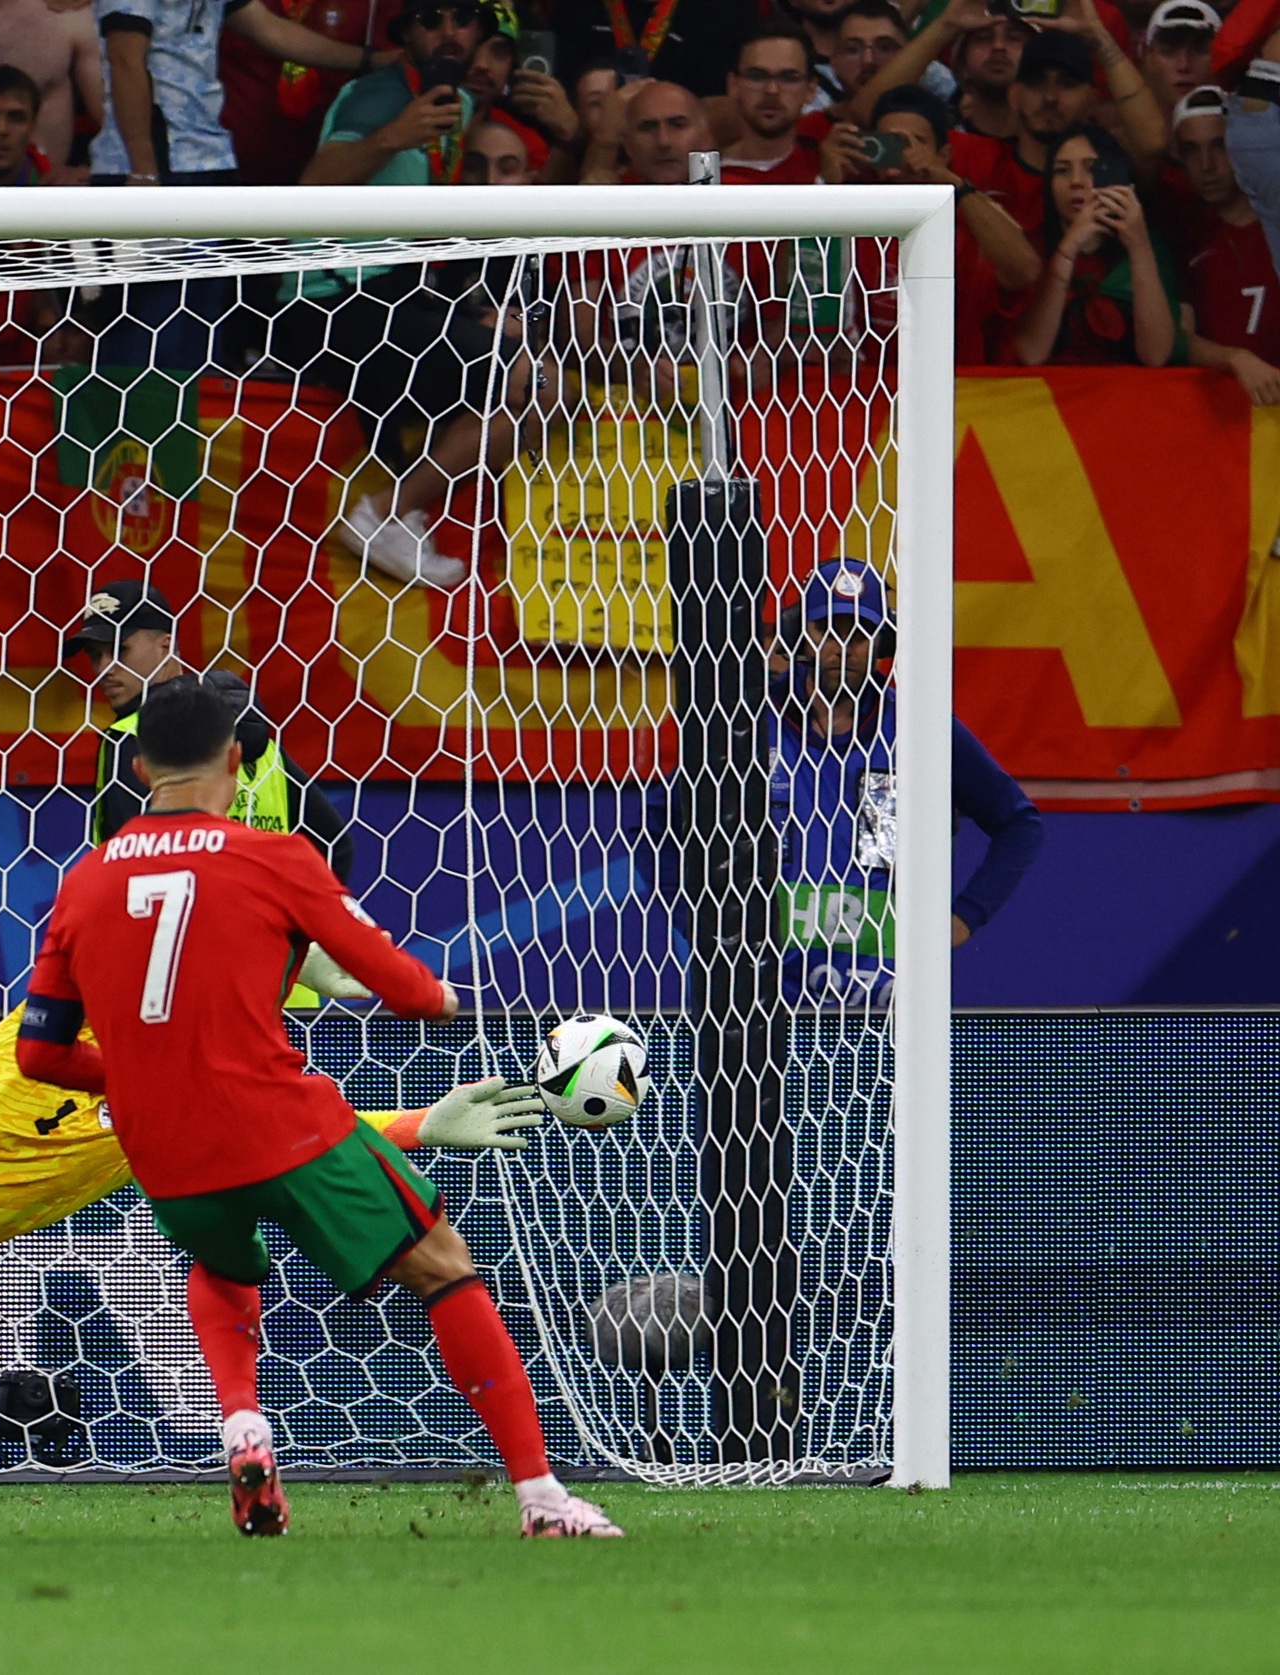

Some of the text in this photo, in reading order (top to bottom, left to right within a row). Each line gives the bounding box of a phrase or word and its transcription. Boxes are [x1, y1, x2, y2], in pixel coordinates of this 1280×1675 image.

[1240, 285, 1266, 335] 7
[103, 829, 226, 863] RONALDO
[127, 870, 196, 1025] 7
[34, 1098, 78, 1135] 1
